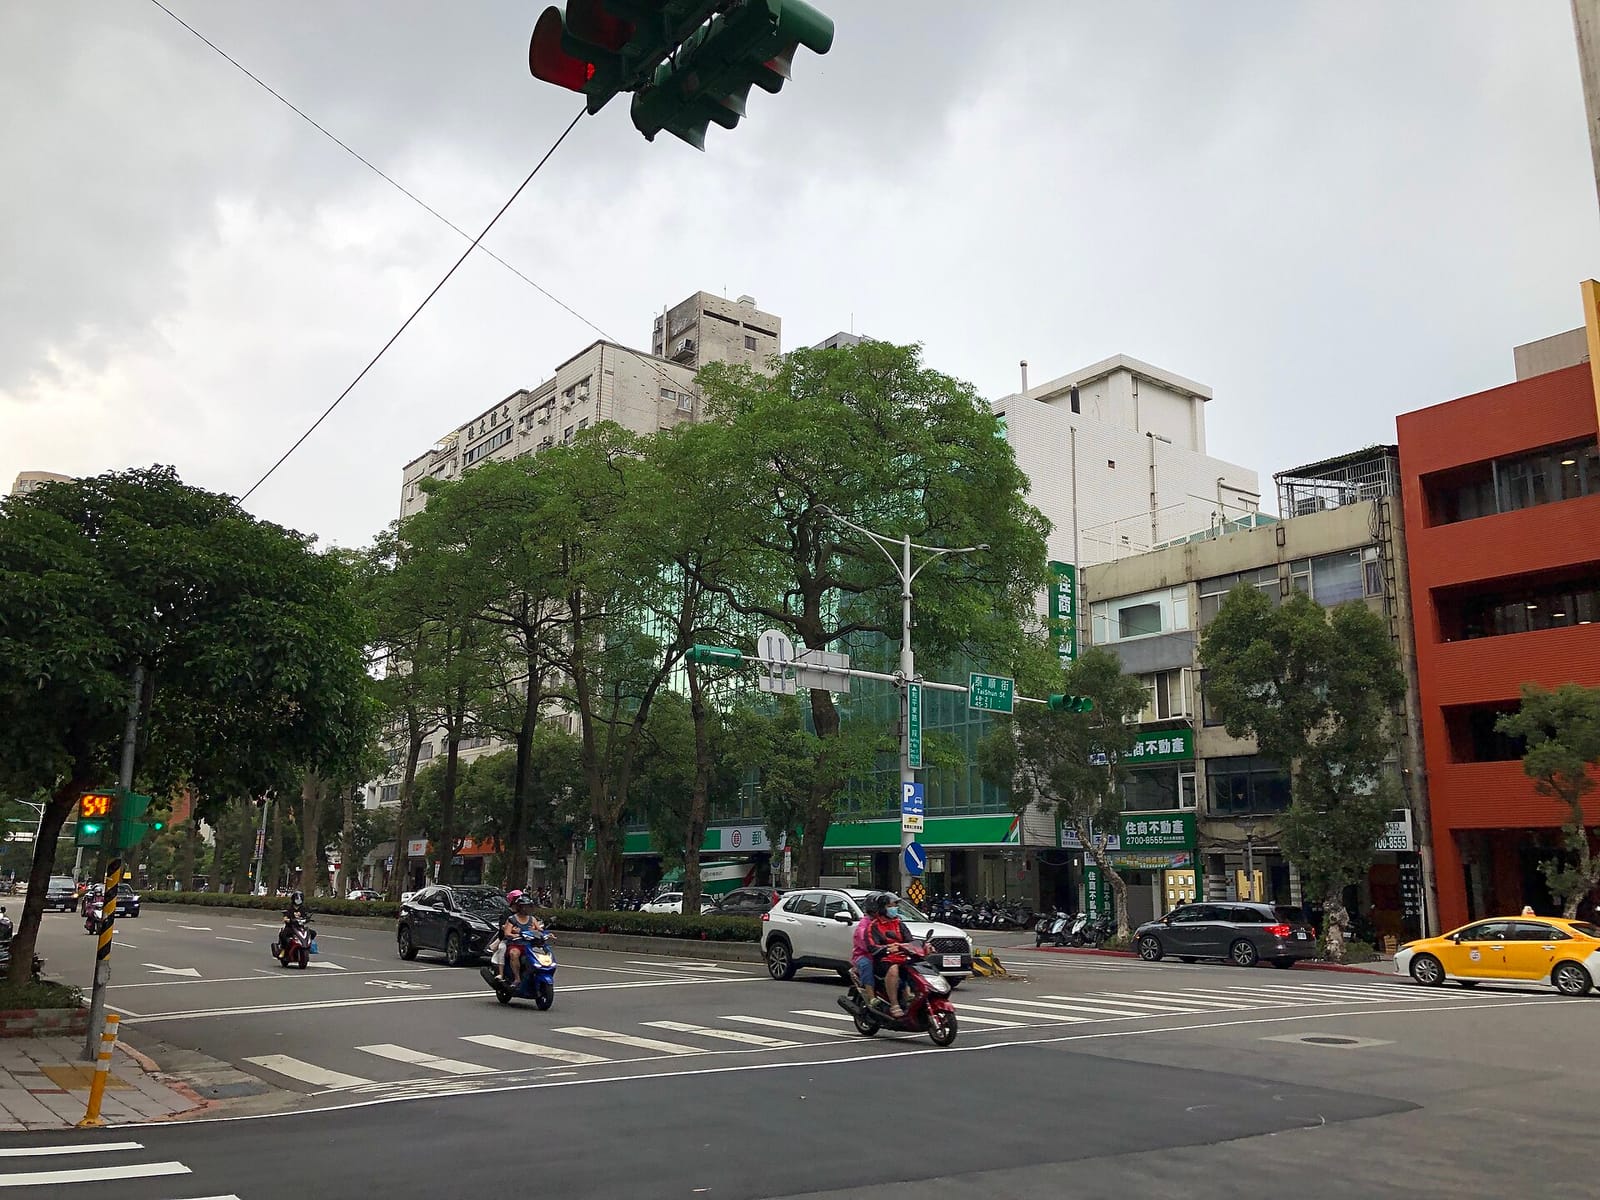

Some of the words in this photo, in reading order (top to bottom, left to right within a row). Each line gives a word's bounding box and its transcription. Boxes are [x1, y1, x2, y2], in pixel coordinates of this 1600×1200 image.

[975, 676, 1009, 691] 泰順街
[903, 784, 915, 803] P
[83, 795, 107, 817] 54
[1125, 820, 1185, 835] 住商不動產
[1126, 836, 1164, 846] 2700-8555
[1088, 871, 1097, 920] 住商不動產
